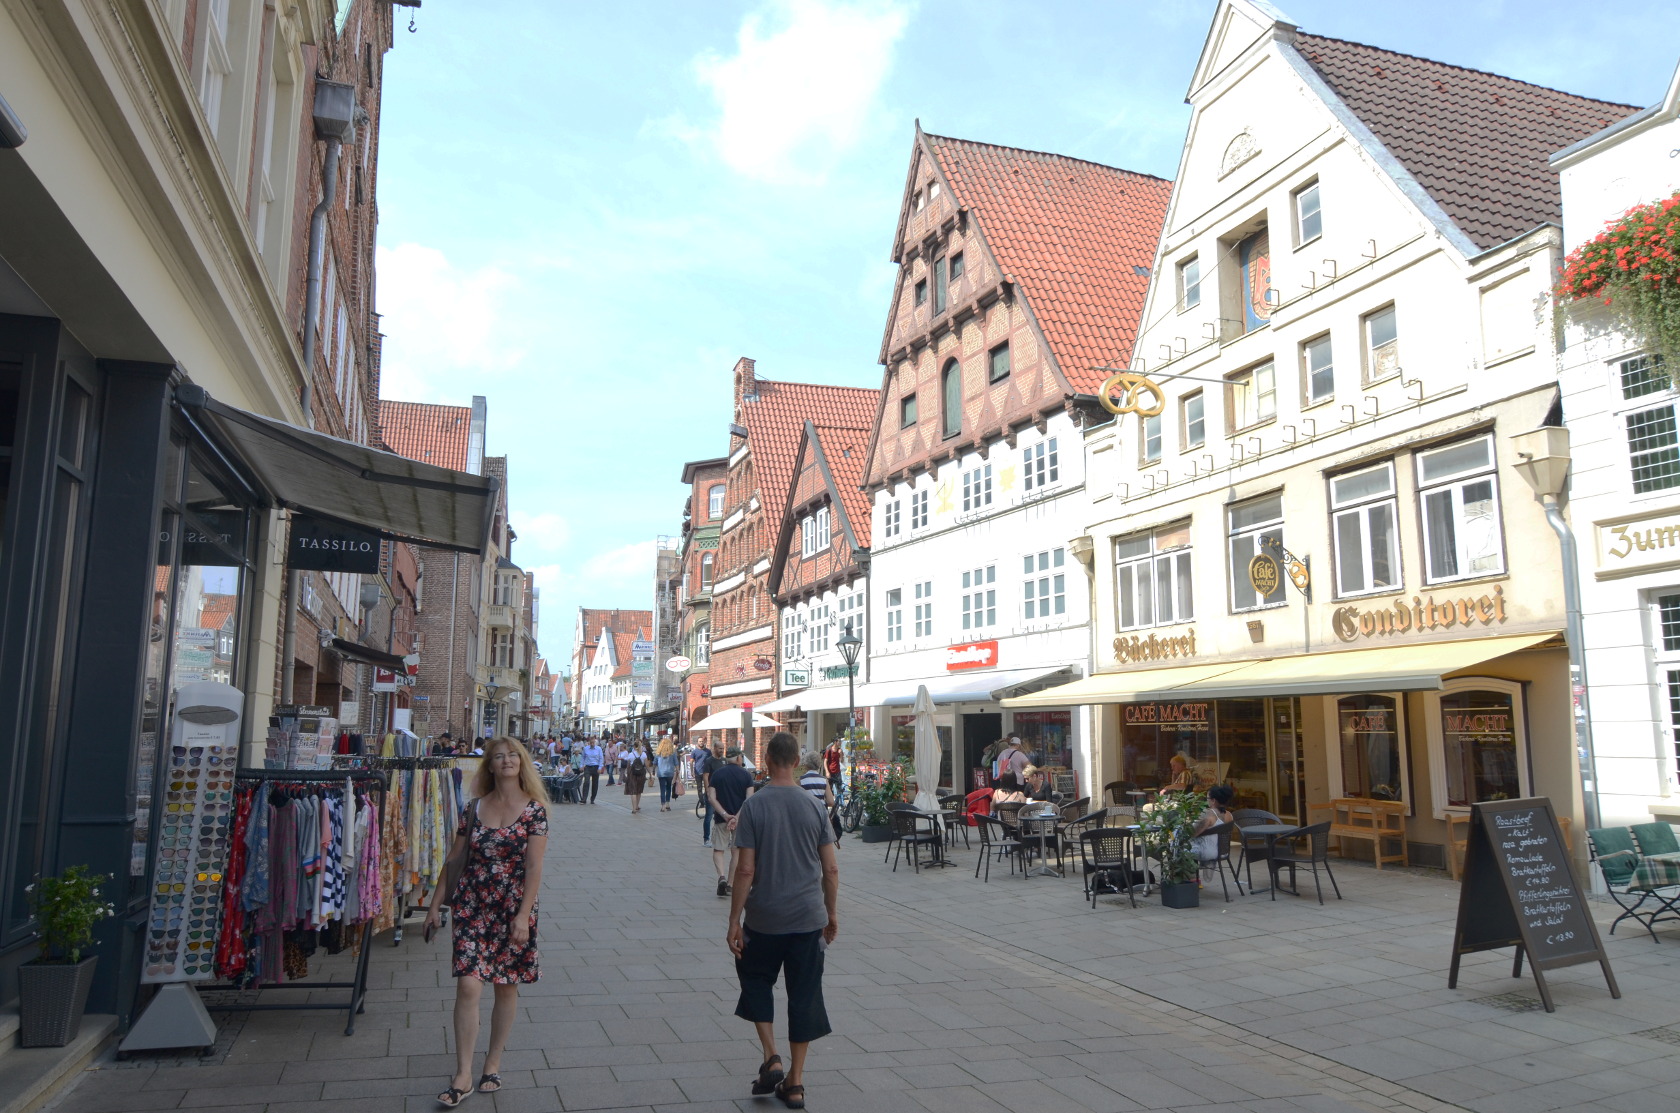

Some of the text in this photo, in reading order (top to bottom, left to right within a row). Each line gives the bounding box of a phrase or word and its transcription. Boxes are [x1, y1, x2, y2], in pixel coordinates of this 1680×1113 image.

[1253, 561, 1275, 580] Café
[1332, 584, 1507, 643] Conditorei
[1113, 628, 1197, 664] Bäckerei
[790, 673, 806, 683] Tee
[1125, 702, 1208, 722] CAFÉ MACHT
[1351, 712, 1385, 731] CAFÉ
[1446, 715, 1508, 731] MACHT
[1496, 812, 1533, 827] Roastbeef
[1519, 835, 1548, 851] gebraten
[1511, 862, 1556, 877] Bratkartoffeln
[1524, 902, 1571, 916] Bratkartoffeln
[1530, 914, 1564, 928] und Salat
